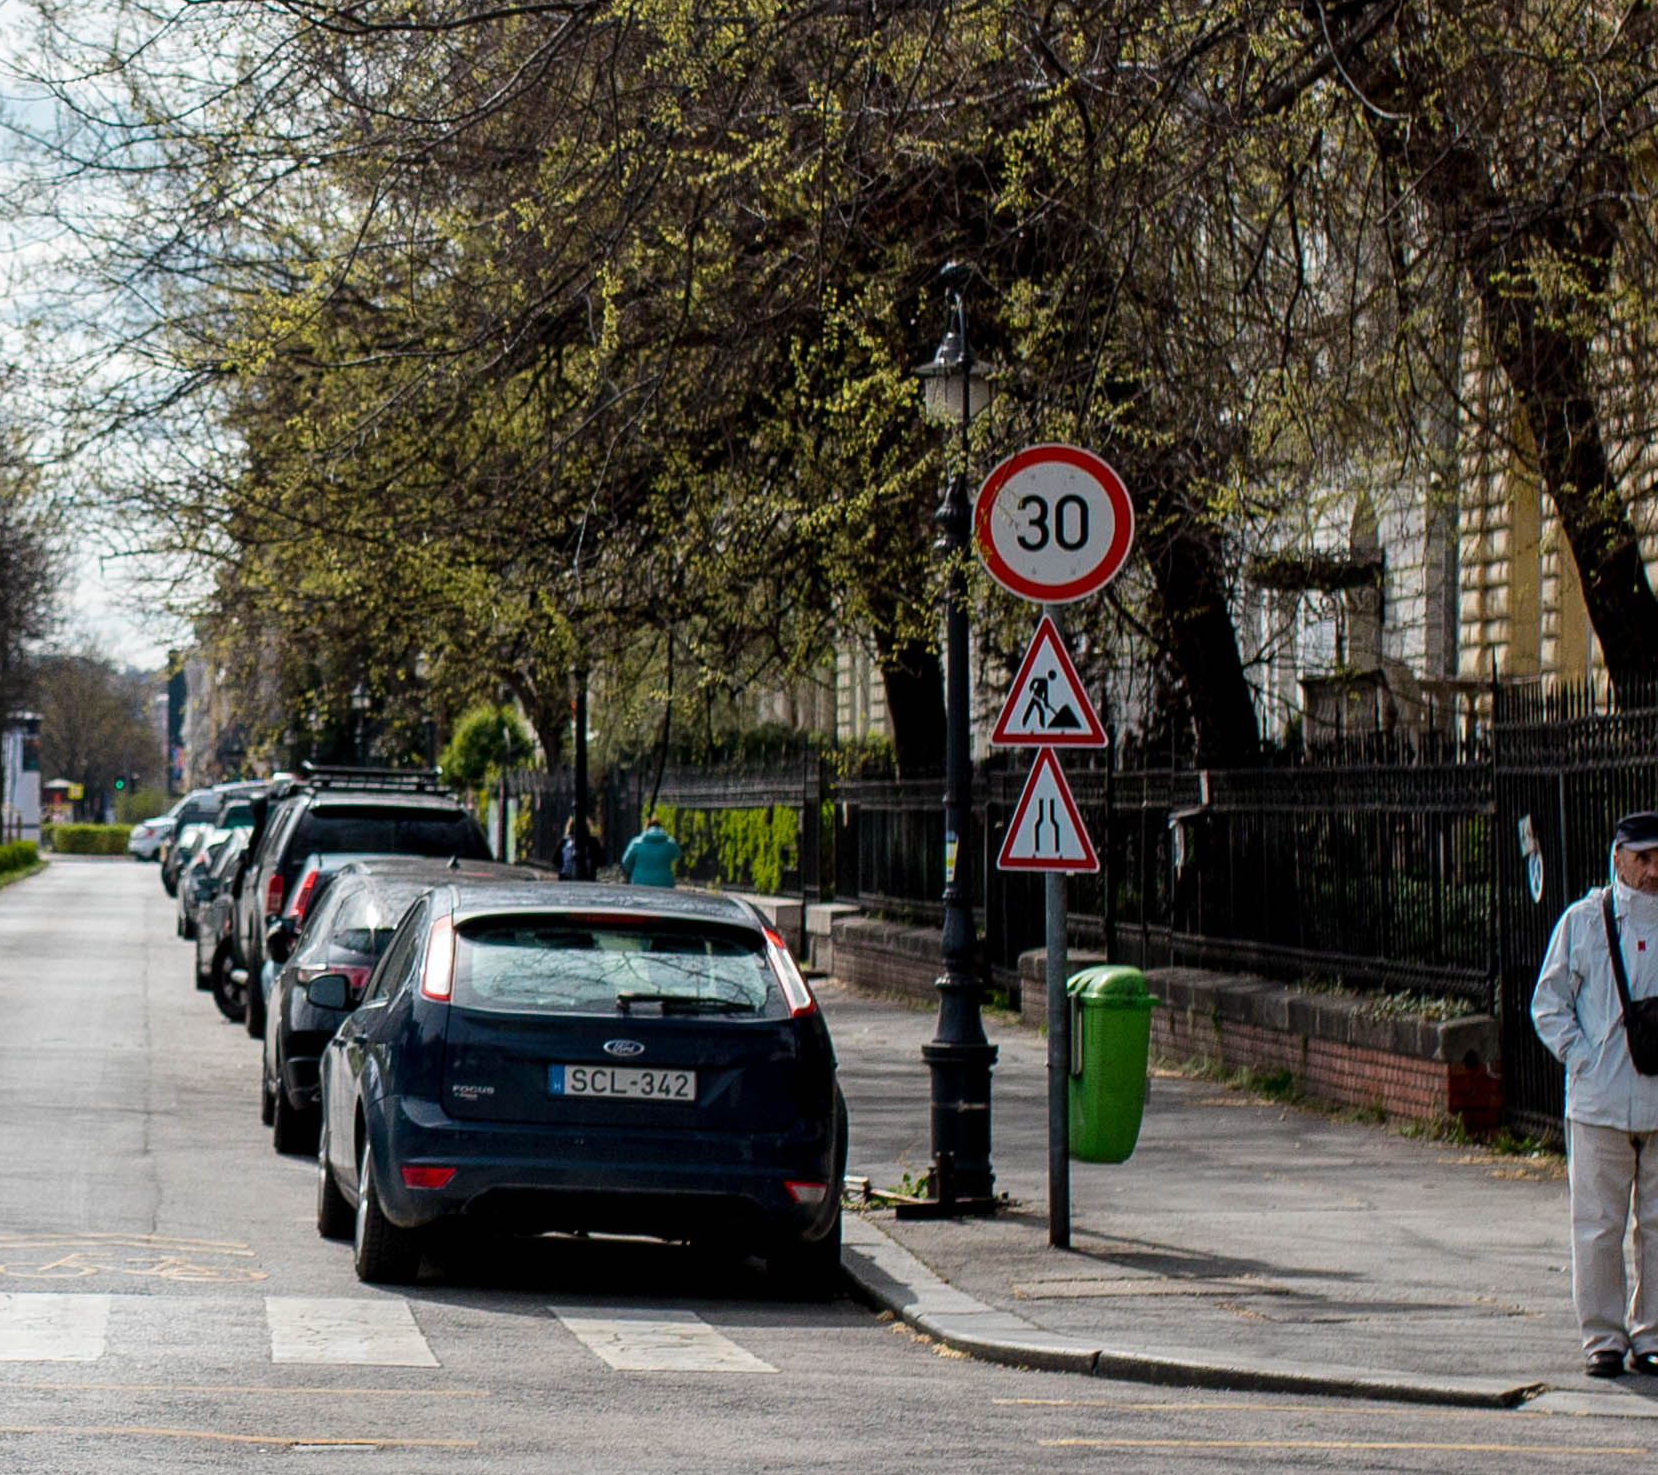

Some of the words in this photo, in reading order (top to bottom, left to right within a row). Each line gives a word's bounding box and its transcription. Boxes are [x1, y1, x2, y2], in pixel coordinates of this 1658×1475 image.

[1017, 494, 1090, 552] 30
[452, 1084, 495, 1095] FOCUS
[571, 1069, 689, 1097] SCL-342
